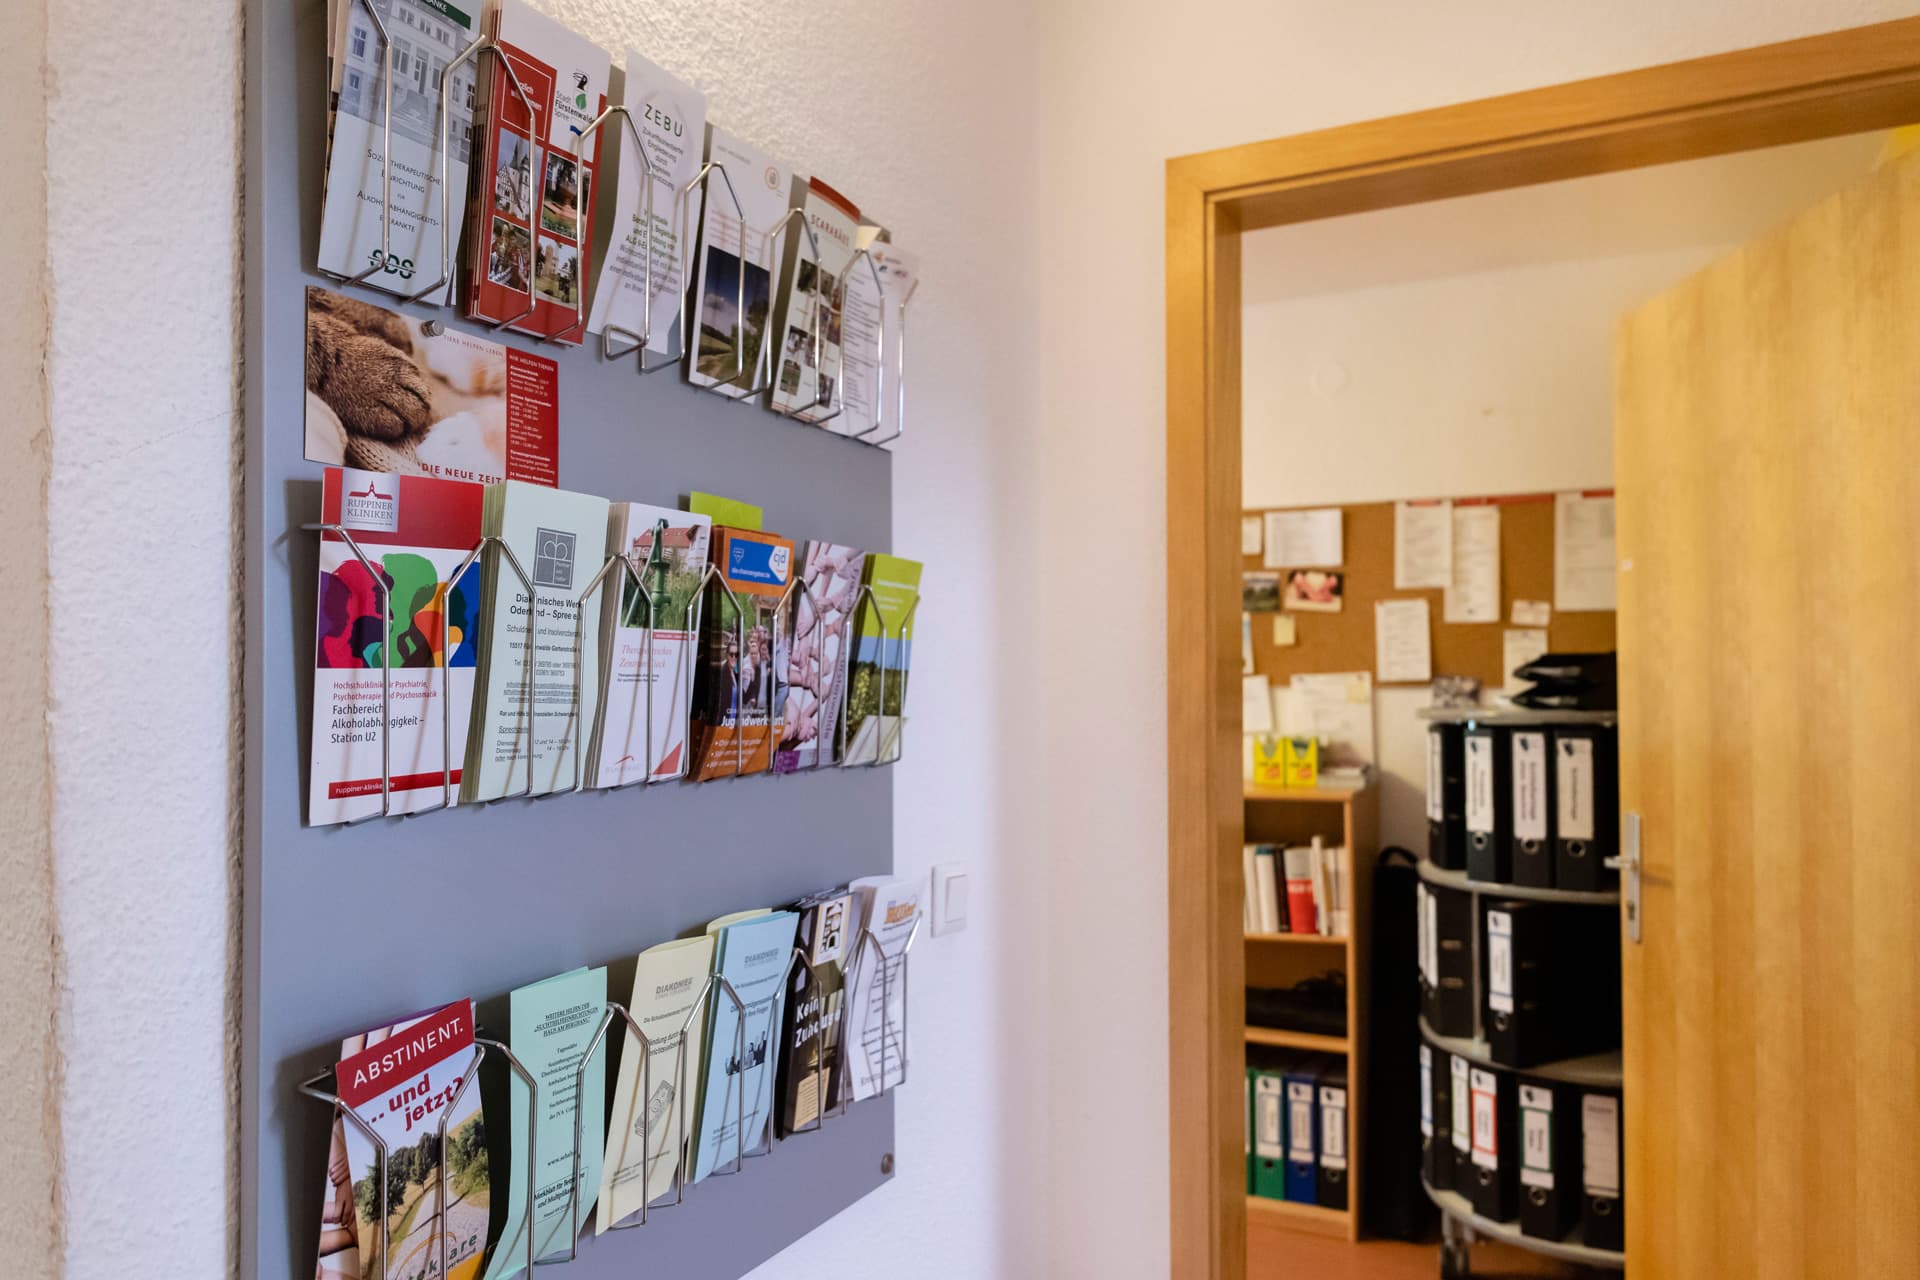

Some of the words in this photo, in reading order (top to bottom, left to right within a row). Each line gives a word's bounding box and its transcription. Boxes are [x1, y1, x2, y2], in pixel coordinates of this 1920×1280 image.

[644, 103, 683, 137] ZEBU
[421, 463, 441, 475] DIE
[445, 467, 475, 480] NEUE
[478, 473, 503, 485] ZEIT
[347, 498, 393, 511] RUPPINER
[347, 508, 393, 520] KLINIKEN
[553, 609, 572, 621] Spree
[332, 691, 382, 702] Psychotherapie
[332, 703, 384, 715] Fachbereich
[331, 731, 363, 744] Station
[365, 731, 377, 742] U2
[796, 996, 819, 1024] Kein
[353, 1017, 463, 1089] ABSTINENT.
[388, 1072, 431, 1113] und
